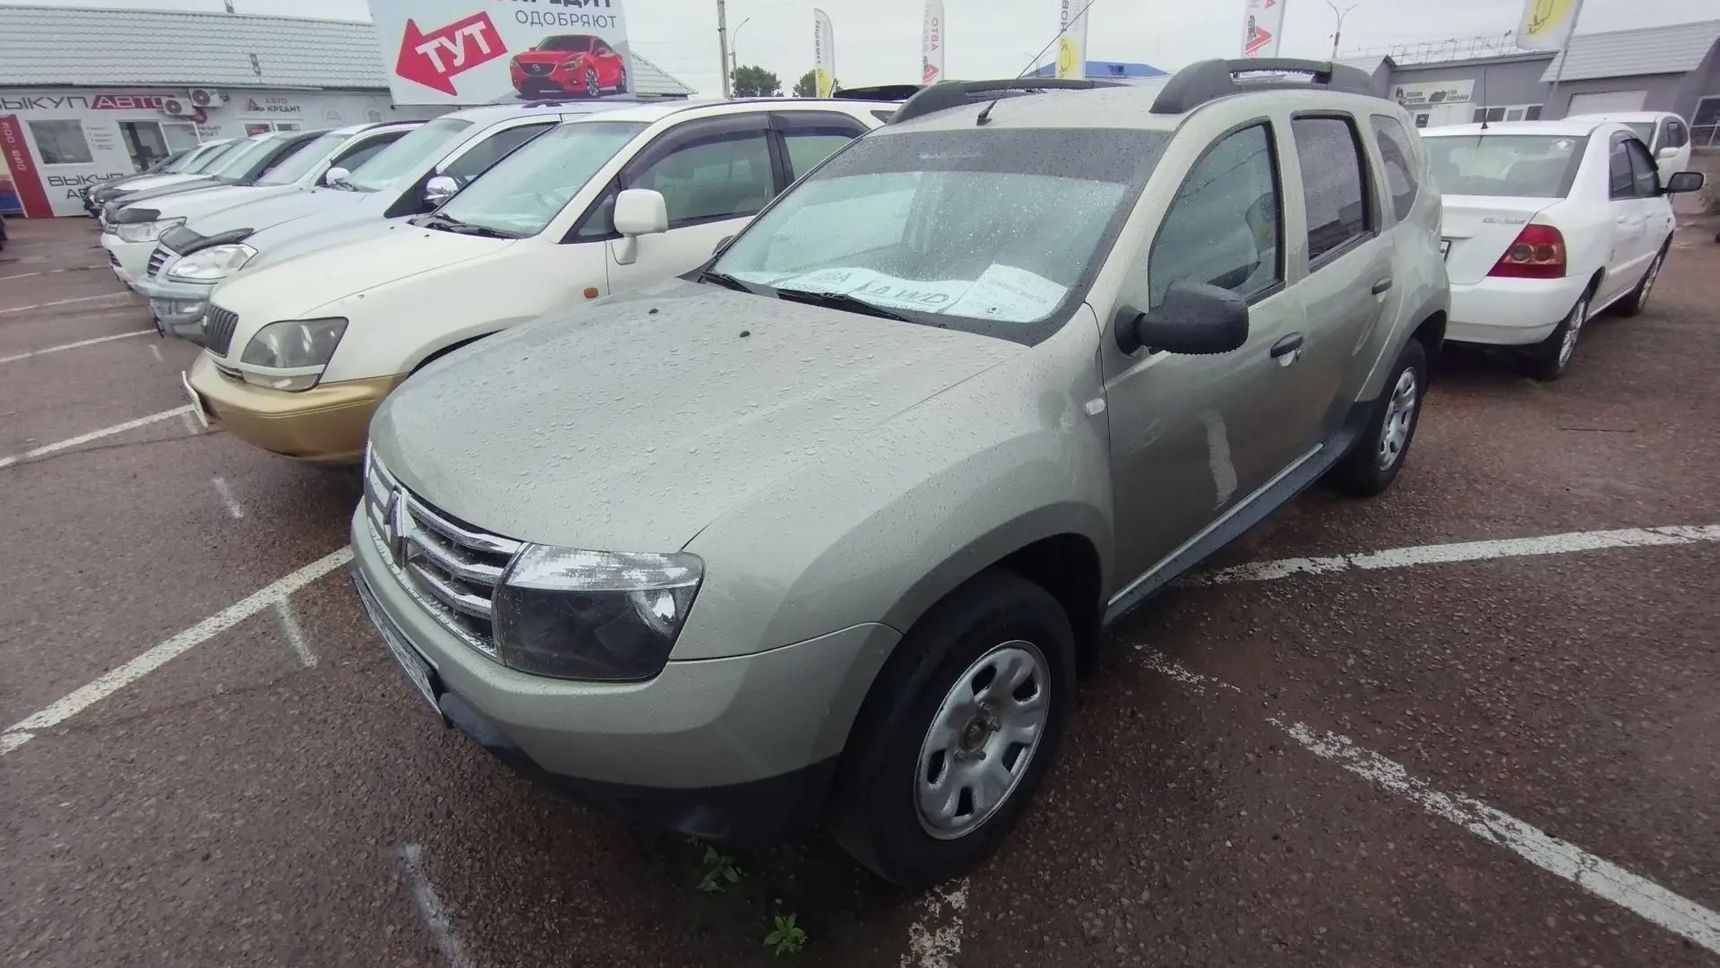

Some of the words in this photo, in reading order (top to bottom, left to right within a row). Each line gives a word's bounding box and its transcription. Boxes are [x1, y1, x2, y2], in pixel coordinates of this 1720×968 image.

[515, 9, 618, 29] ОДОБРЯЮТ
[415, 21, 491, 74] ТУТ
[0, 96, 89, 110] ЫКУП
[264, 97, 288, 105] АВТО
[267, 105, 300, 113] КРЕДИТ
